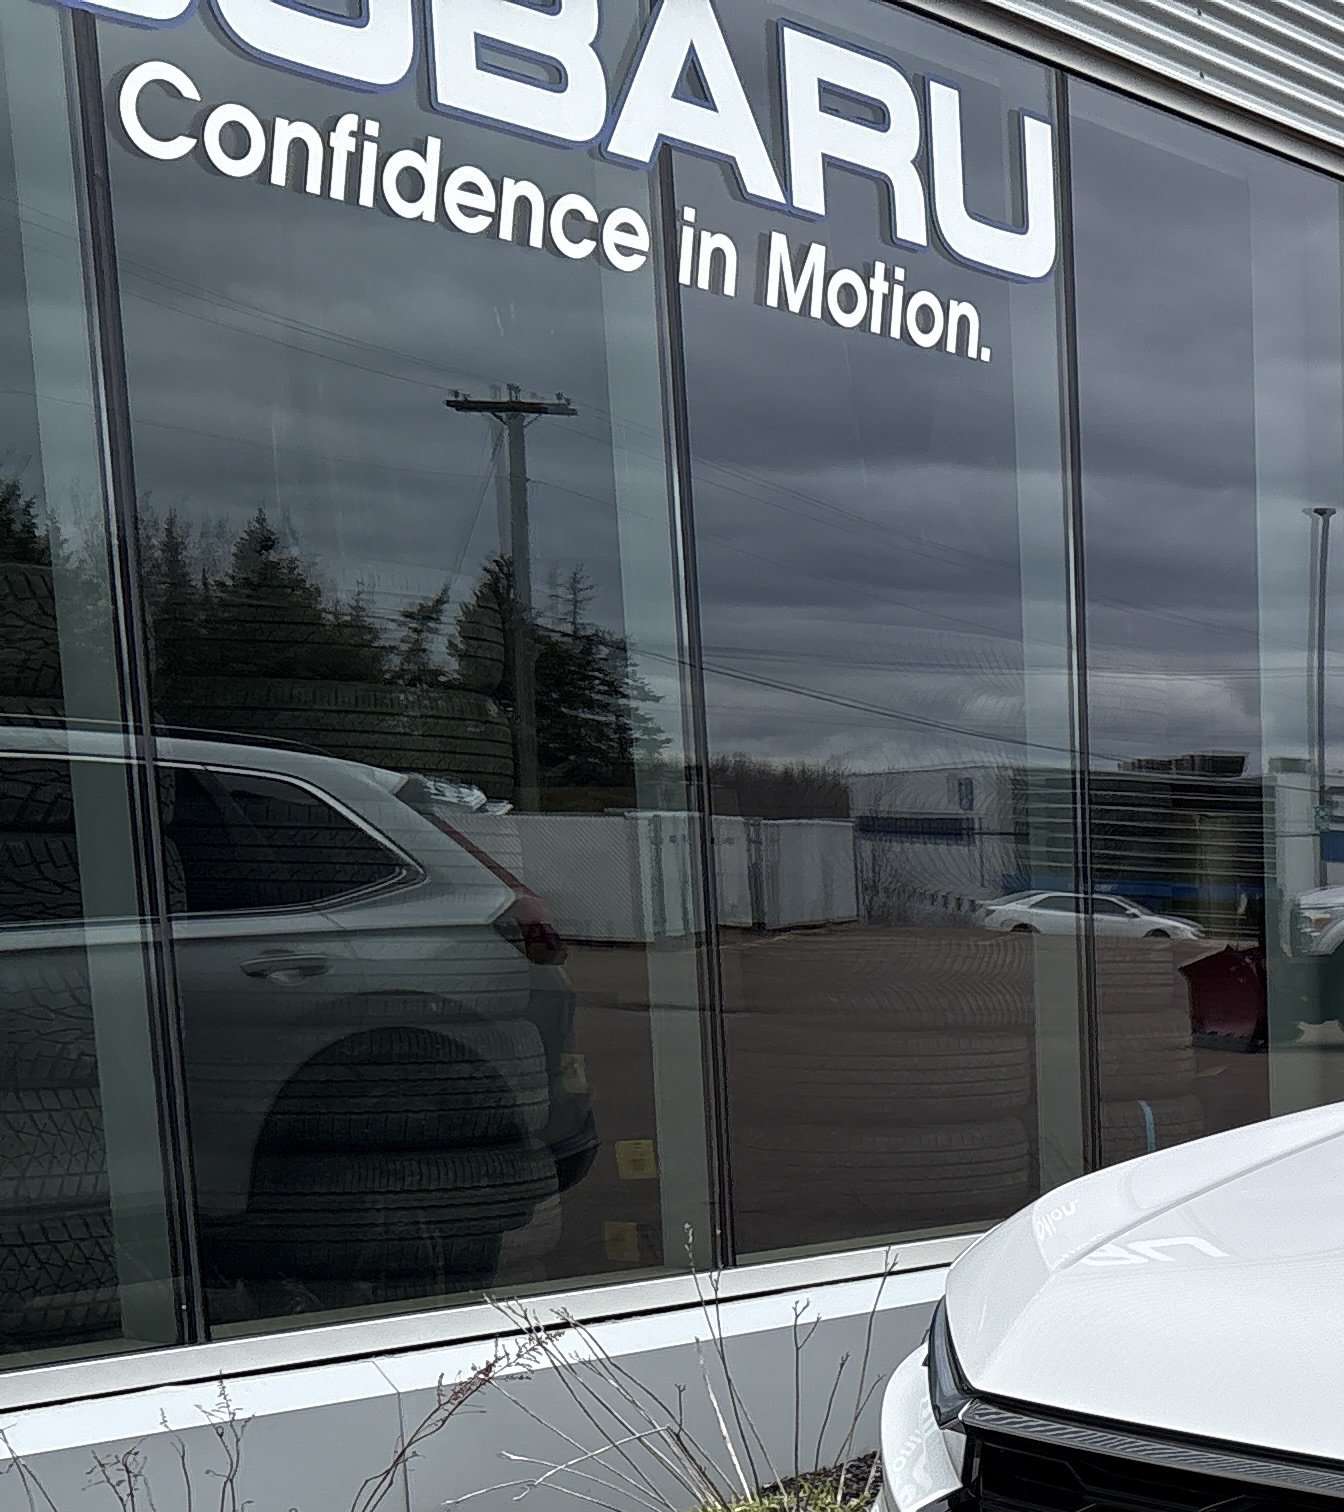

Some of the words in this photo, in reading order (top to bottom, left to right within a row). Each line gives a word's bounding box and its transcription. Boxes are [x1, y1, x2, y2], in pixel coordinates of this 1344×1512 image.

[30, 0, 1057, 282] BARU
[119, 61, 650, 272] Confidence
[678, 206, 738, 297] in
[766, 230, 992, 362] Motion.
